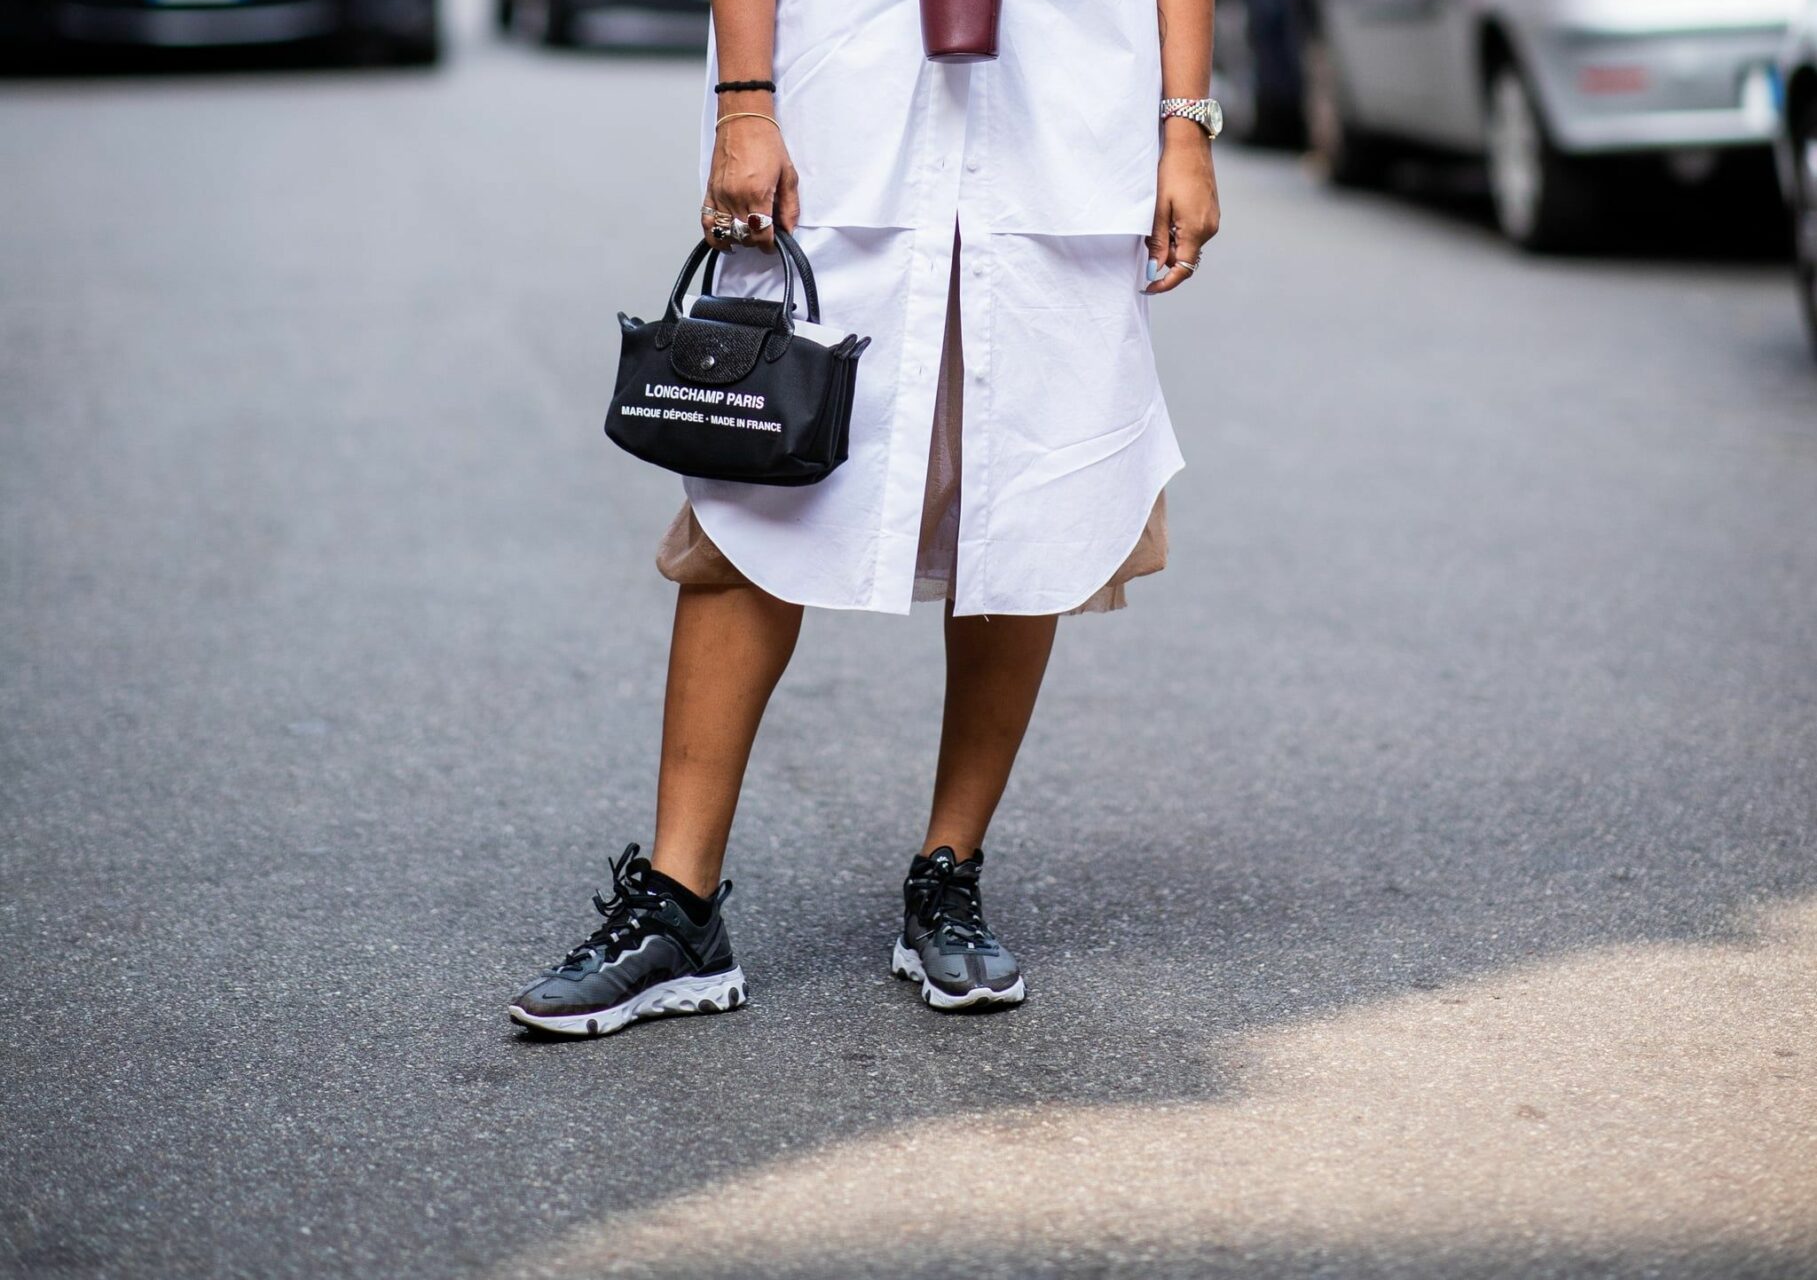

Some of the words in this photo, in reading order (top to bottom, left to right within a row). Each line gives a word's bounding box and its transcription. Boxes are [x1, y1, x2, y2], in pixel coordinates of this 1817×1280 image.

[645, 383, 724, 405] LONGCHAMP
[726, 392, 765, 410] PARIS
[621, 405, 661, 419] MARQUE
[663, 408, 704, 423] DÉPOSÉE
[710, 415, 735, 427] MADE
[736, 418, 746, 429] IN
[747, 419, 782, 433] FRANCE
